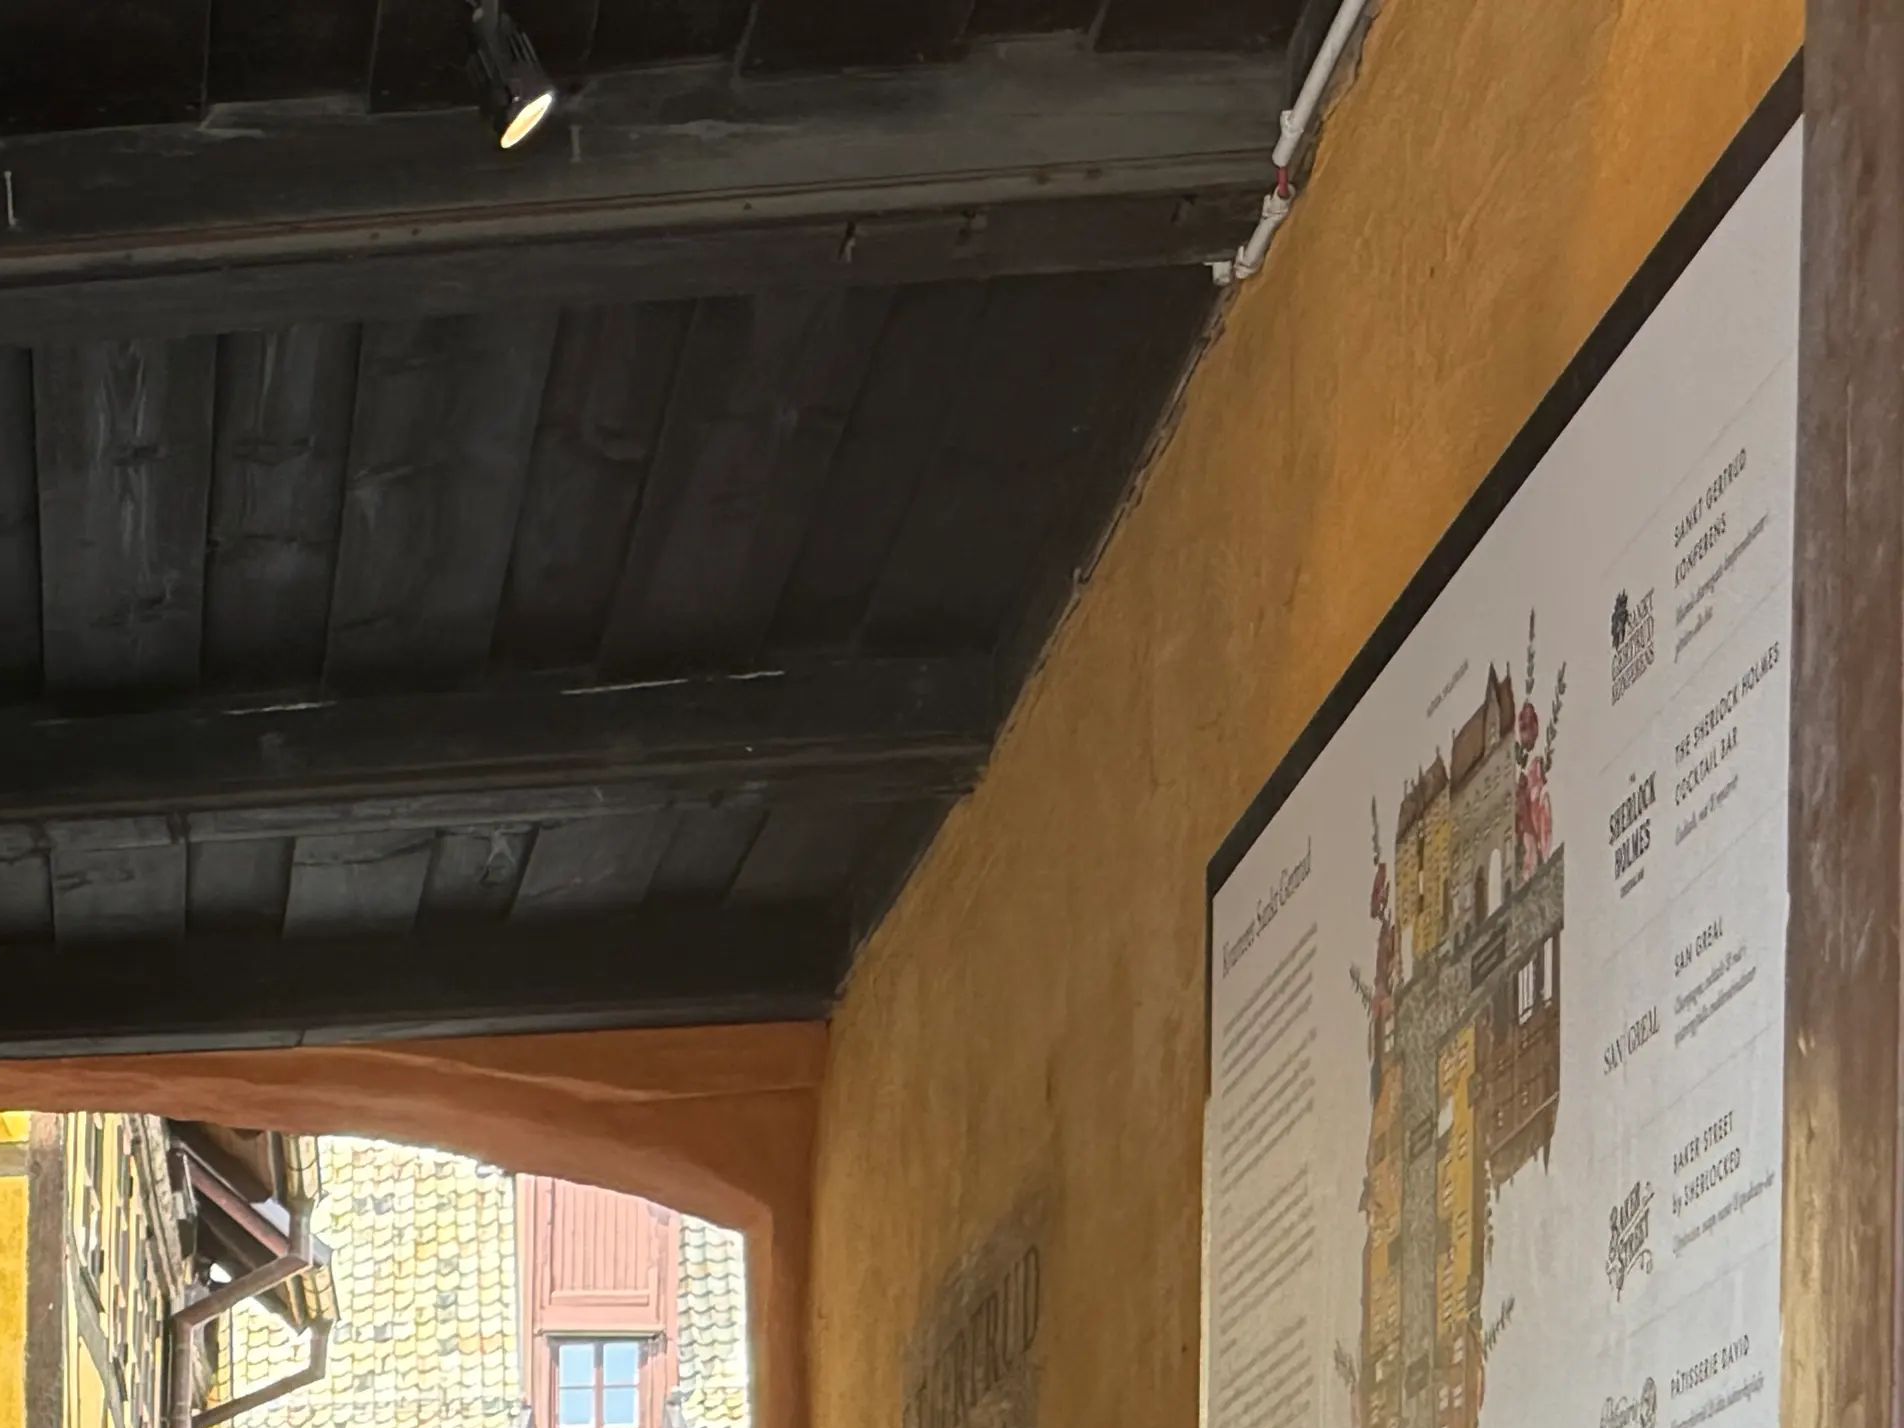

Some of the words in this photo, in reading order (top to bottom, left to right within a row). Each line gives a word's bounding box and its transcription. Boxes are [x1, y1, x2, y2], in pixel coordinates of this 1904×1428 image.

[1674, 497, 1703, 548] SANKT
[1706, 447, 1747, 510] GERTRUD
[1675, 512, 1726, 589] KONFERENS
[1675, 733, 1691, 766] THE
[1693, 684, 1740, 748] SHERLOCK
[1741, 641, 1780, 698] HOLMES
[1675, 748, 1718, 806] COCKTAIL
[1720, 726, 1738, 761] BAR
[1609, 770, 1657, 846] SHERLOCK
[1615, 818, 1651, 880] HOLMES
[1674, 943, 1693, 978] SAN
[1696, 915, 1723, 957] GREAL
[1673, 1136, 1700, 1175] BAKER
[1703, 1110, 1734, 1152] STREET
[1684, 1147, 1741, 1206] SHERLOCKED
[1721, 1334, 1750, 1371] DAVID
